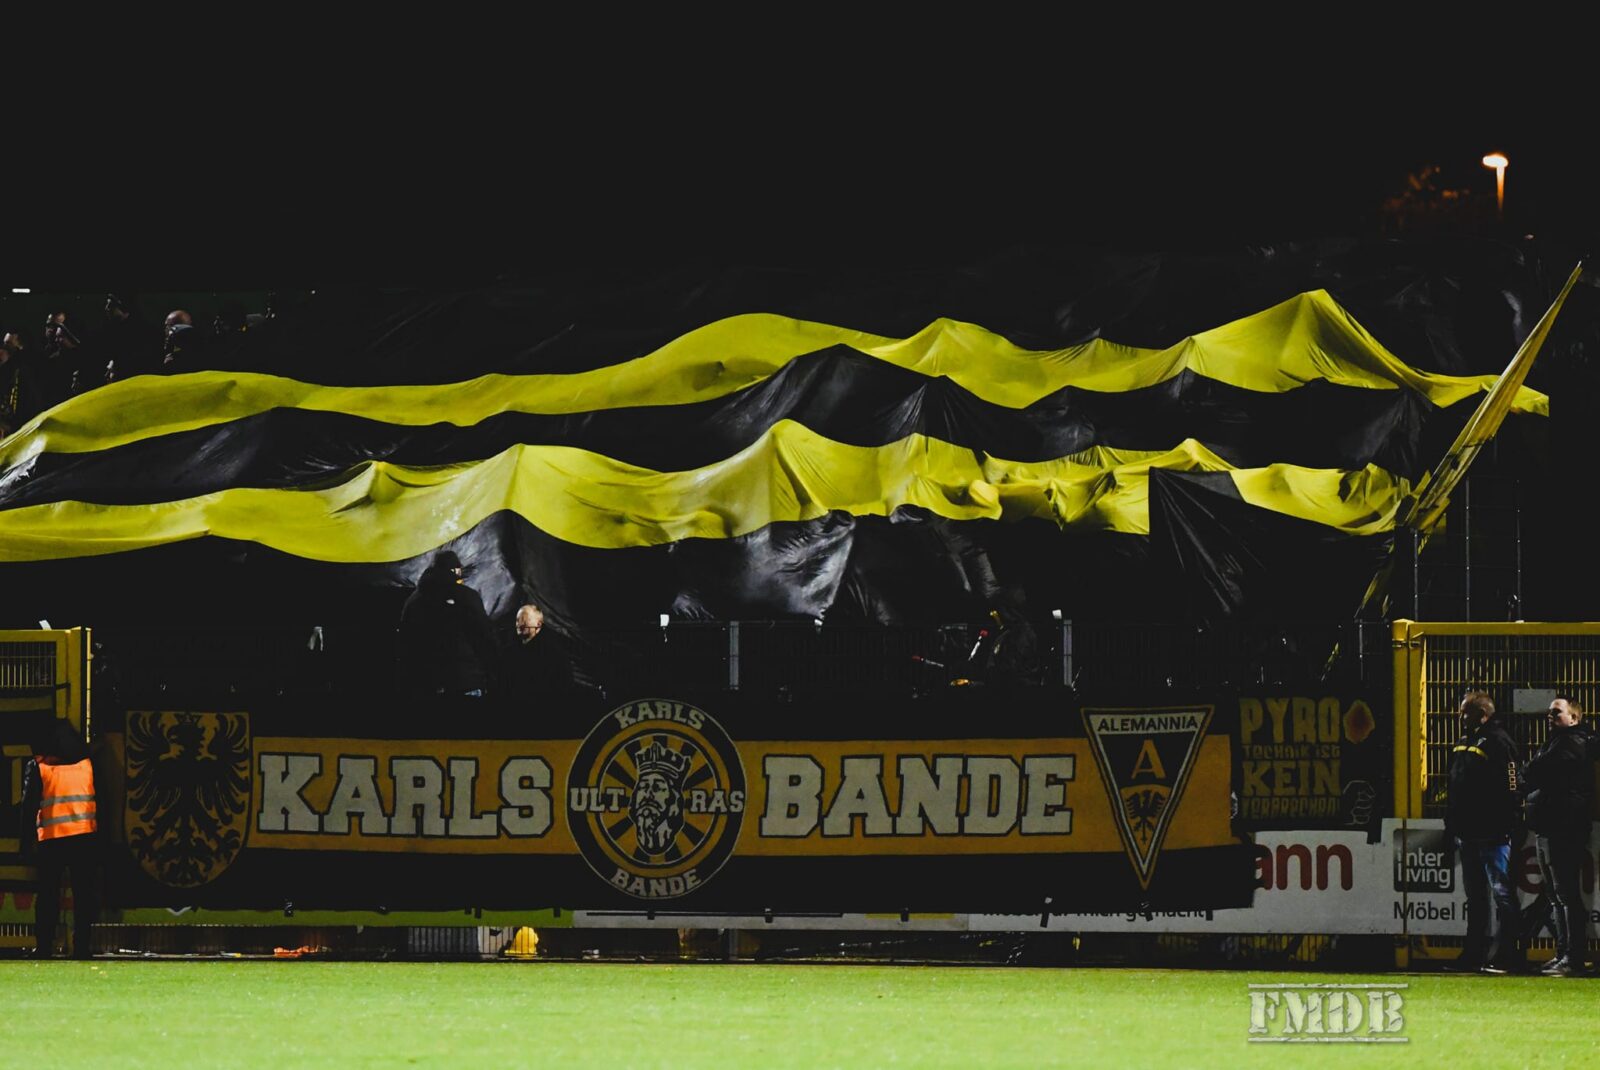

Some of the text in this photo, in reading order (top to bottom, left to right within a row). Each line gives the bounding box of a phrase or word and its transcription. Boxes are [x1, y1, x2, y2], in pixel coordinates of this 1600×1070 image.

[614, 702, 705, 730] KARLS
[1098, 716, 1198, 732] ALEMANNIA
[1239, 696, 1340, 744] PYRO
[1131, 739, 1167, 780] A
[1241, 760, 1342, 797] KEIN
[257, 752, 554, 839] KARLS
[570, 787, 745, 813] ULT RAS
[759, 754, 1076, 838] BANDE
[610, 868, 701, 896] BANDE
[1397, 862, 1451, 889] living
[1394, 901, 1455, 920] Möbel
